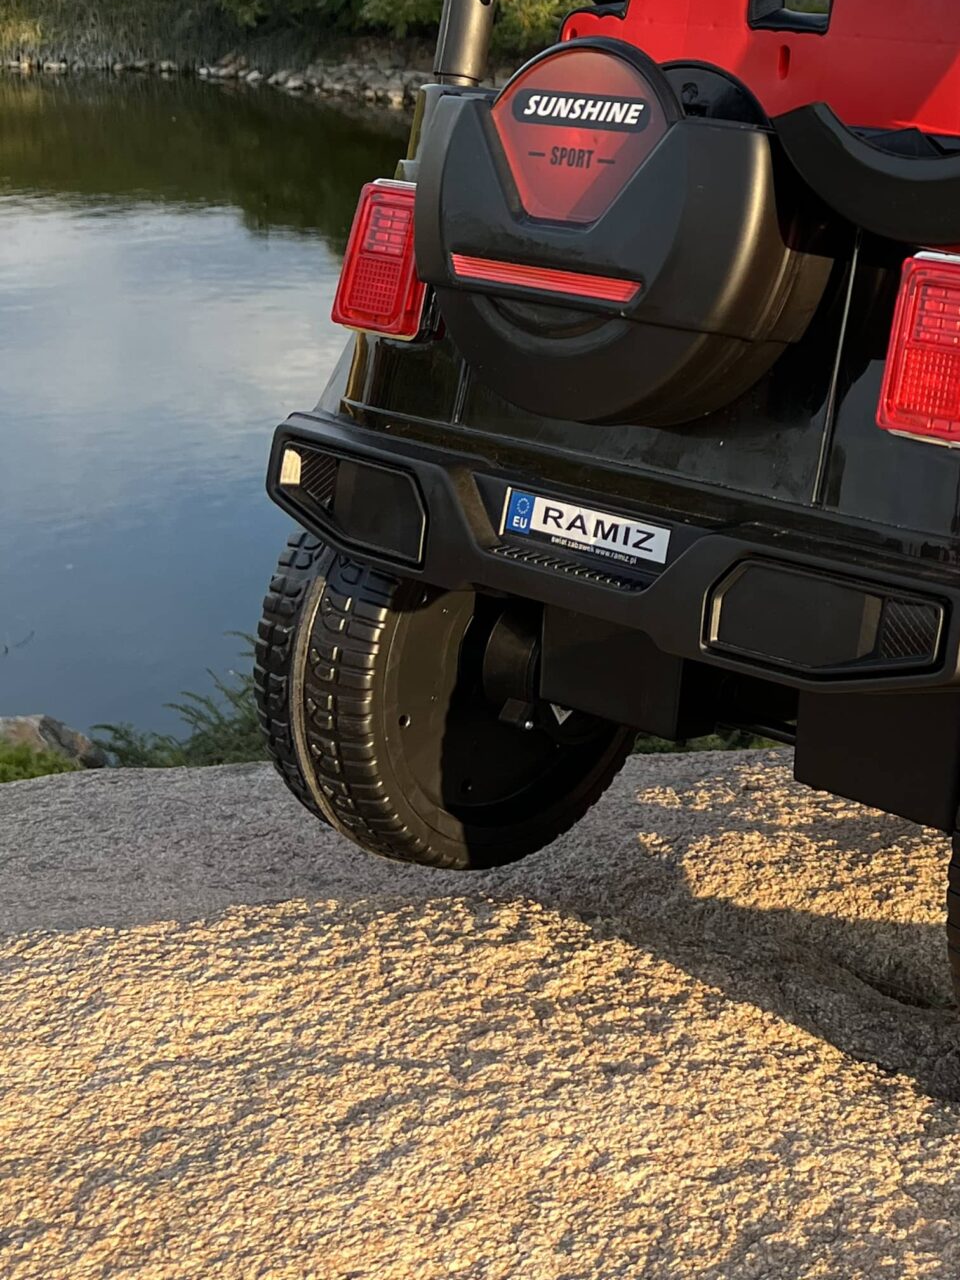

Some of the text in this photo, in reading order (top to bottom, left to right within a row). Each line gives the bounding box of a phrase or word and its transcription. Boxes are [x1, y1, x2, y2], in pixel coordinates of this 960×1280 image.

[523, 95, 644, 125] SUNSHINE
[550, 146, 594, 169] SPORT
[512, 515, 528, 529] EU
[542, 506, 656, 552] RAMIZ
